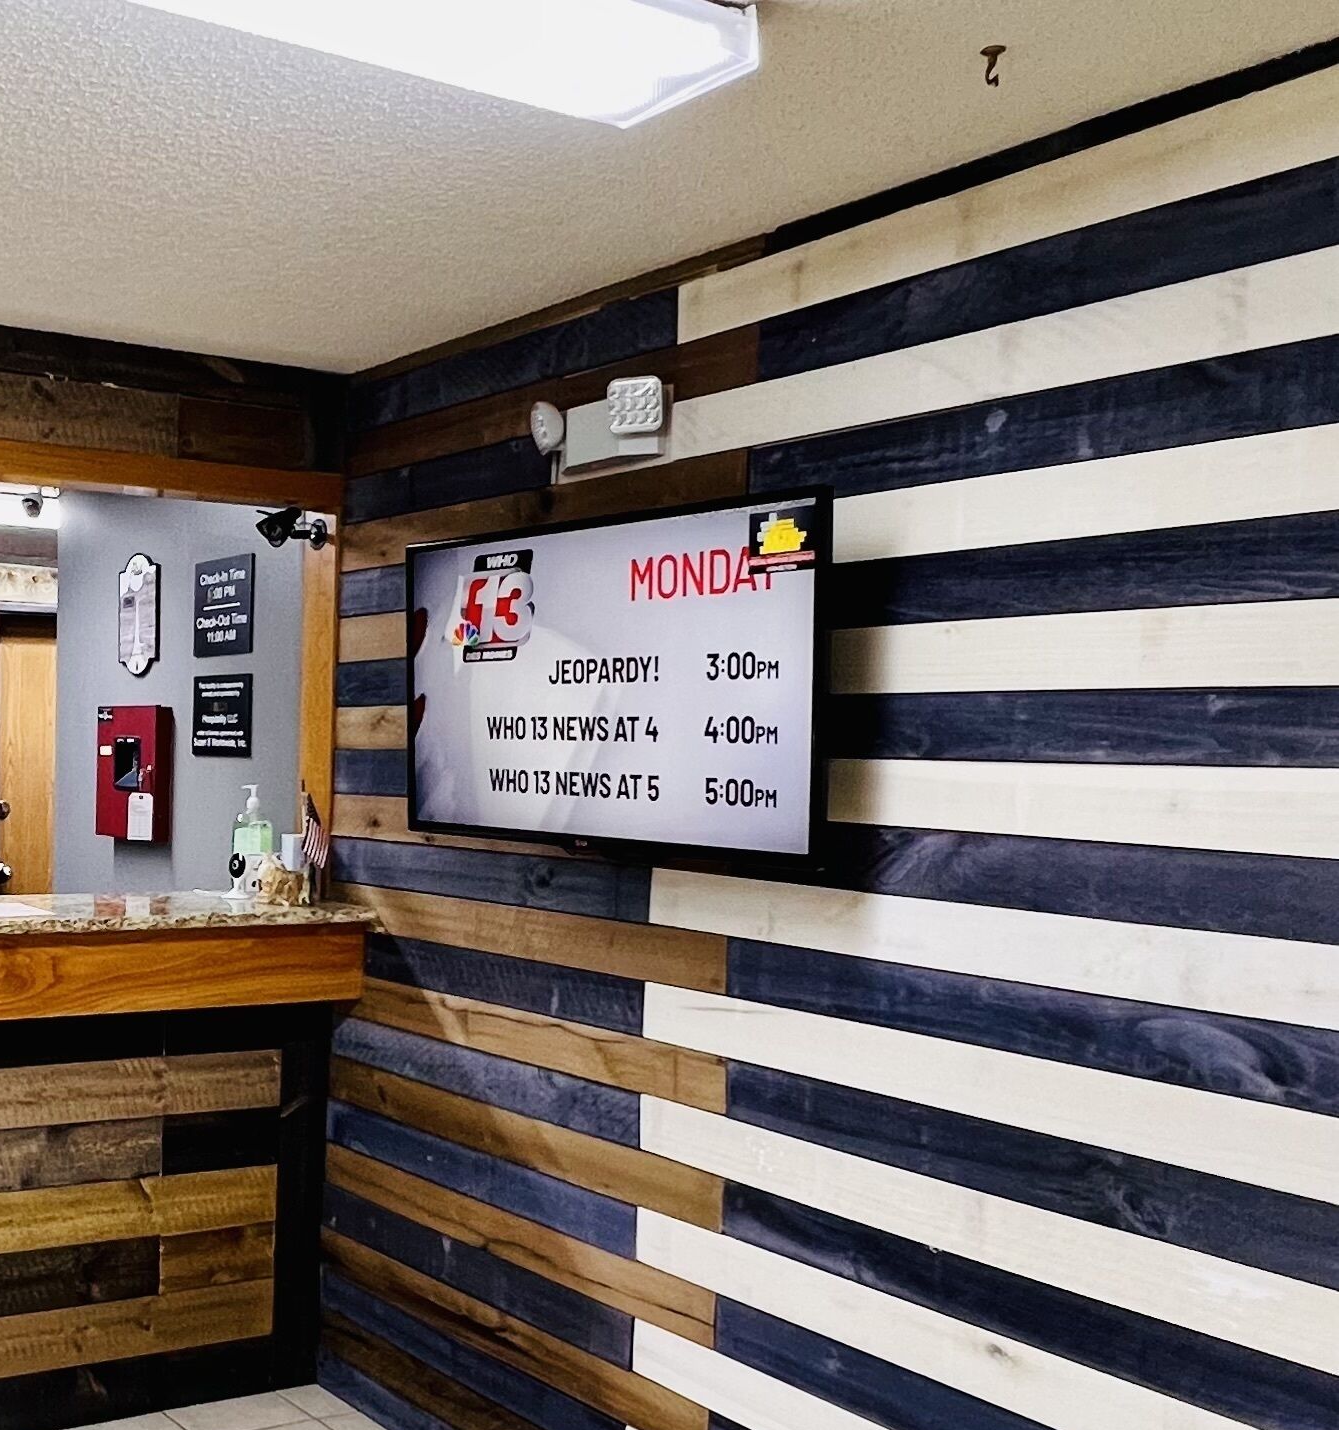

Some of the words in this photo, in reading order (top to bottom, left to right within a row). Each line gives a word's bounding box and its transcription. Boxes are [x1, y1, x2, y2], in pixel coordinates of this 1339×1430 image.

[486, 553, 518, 569] WHO
[200, 570, 228, 586] Check-In
[229, 568, 246, 581] Time
[224, 585, 236, 597] PM
[473, 571, 534, 643] 13
[196, 614, 230, 629] Check-Out
[231, 612, 248, 624] Time
[224, 629, 237, 641] AM
[548, 656, 659, 685] JEOPARDY!
[706, 651, 780, 681] 3:00PM
[486, 716, 526, 740] WHO
[530, 716, 548, 741] 13
[552, 716, 609, 742] NEWS
[613, 716, 640, 743] AT
[644, 716, 659, 743] 4
[704, 715, 778, 745] 4:00PM
[488, 768, 529, 794] WHO
[533, 770, 551, 795] 13
[555, 771, 611, 799] NEWS
[616, 773, 643, 800] AT
[647, 775, 660, 802] 5
[705, 777, 777, 809] 5:00PM
